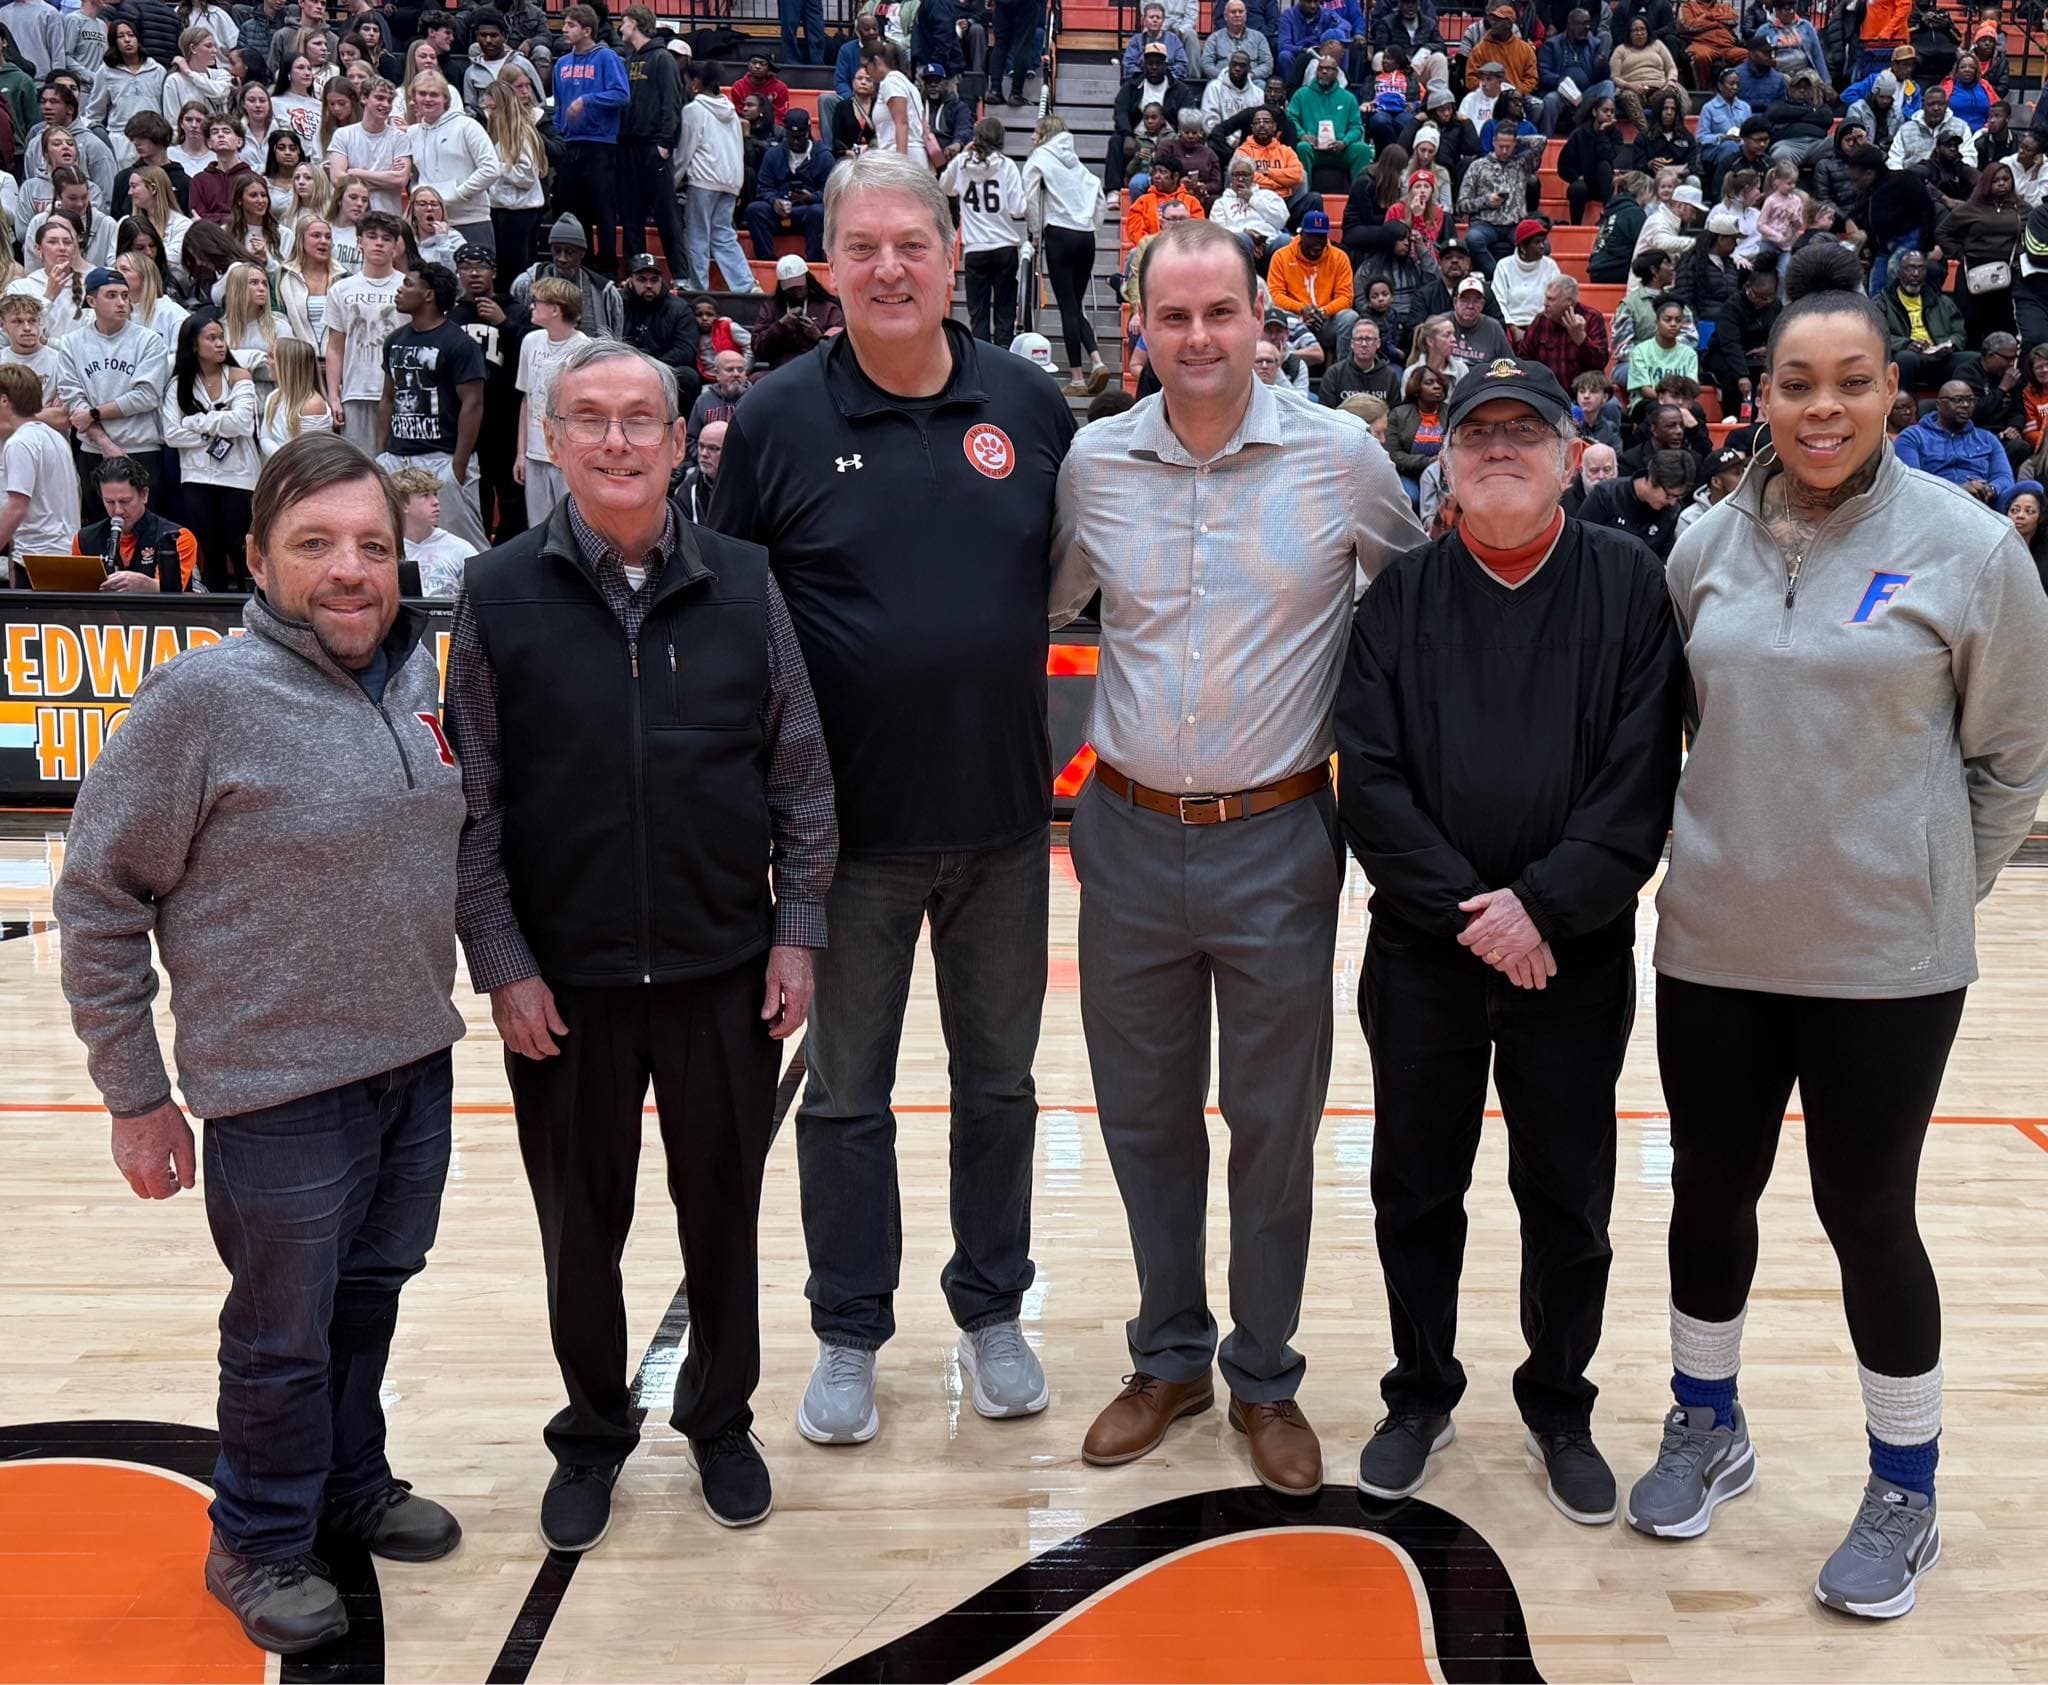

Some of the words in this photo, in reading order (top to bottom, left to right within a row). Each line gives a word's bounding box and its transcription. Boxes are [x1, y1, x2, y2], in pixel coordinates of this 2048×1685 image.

[963, 179, 1000, 214] 46
[84, 360, 102, 379] AIR
[104, 357, 136, 377] FORC
[1842, 568, 1916, 625] F
